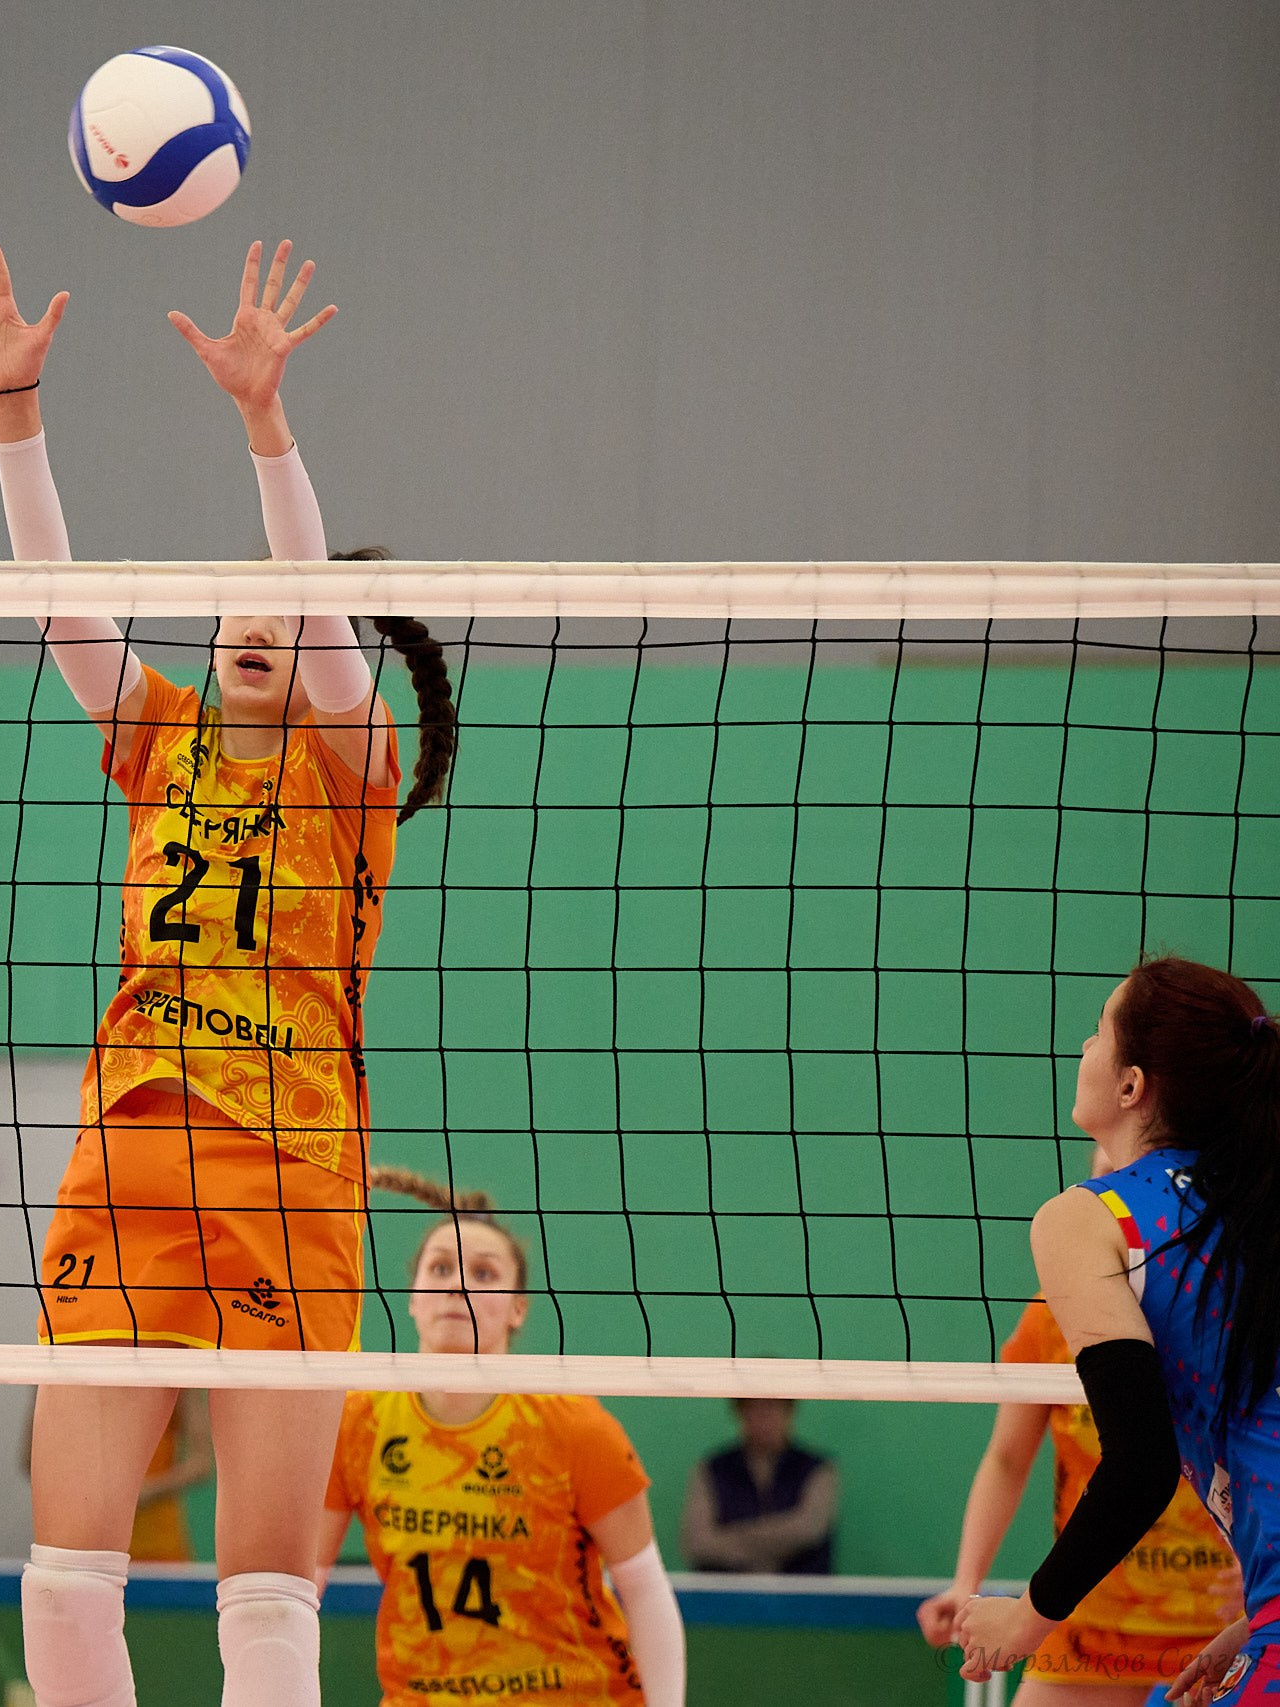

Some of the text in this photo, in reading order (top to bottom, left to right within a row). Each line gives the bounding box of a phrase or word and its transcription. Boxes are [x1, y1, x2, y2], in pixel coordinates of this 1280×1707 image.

[149, 840, 263, 952] 21
[53, 1253, 95, 1289] 21
[230, 1298, 286, 1328] ФОСАГРО
[373, 1502, 530, 1540] СЕВЕРЯНКА
[407, 1551, 501, 1632] 14
